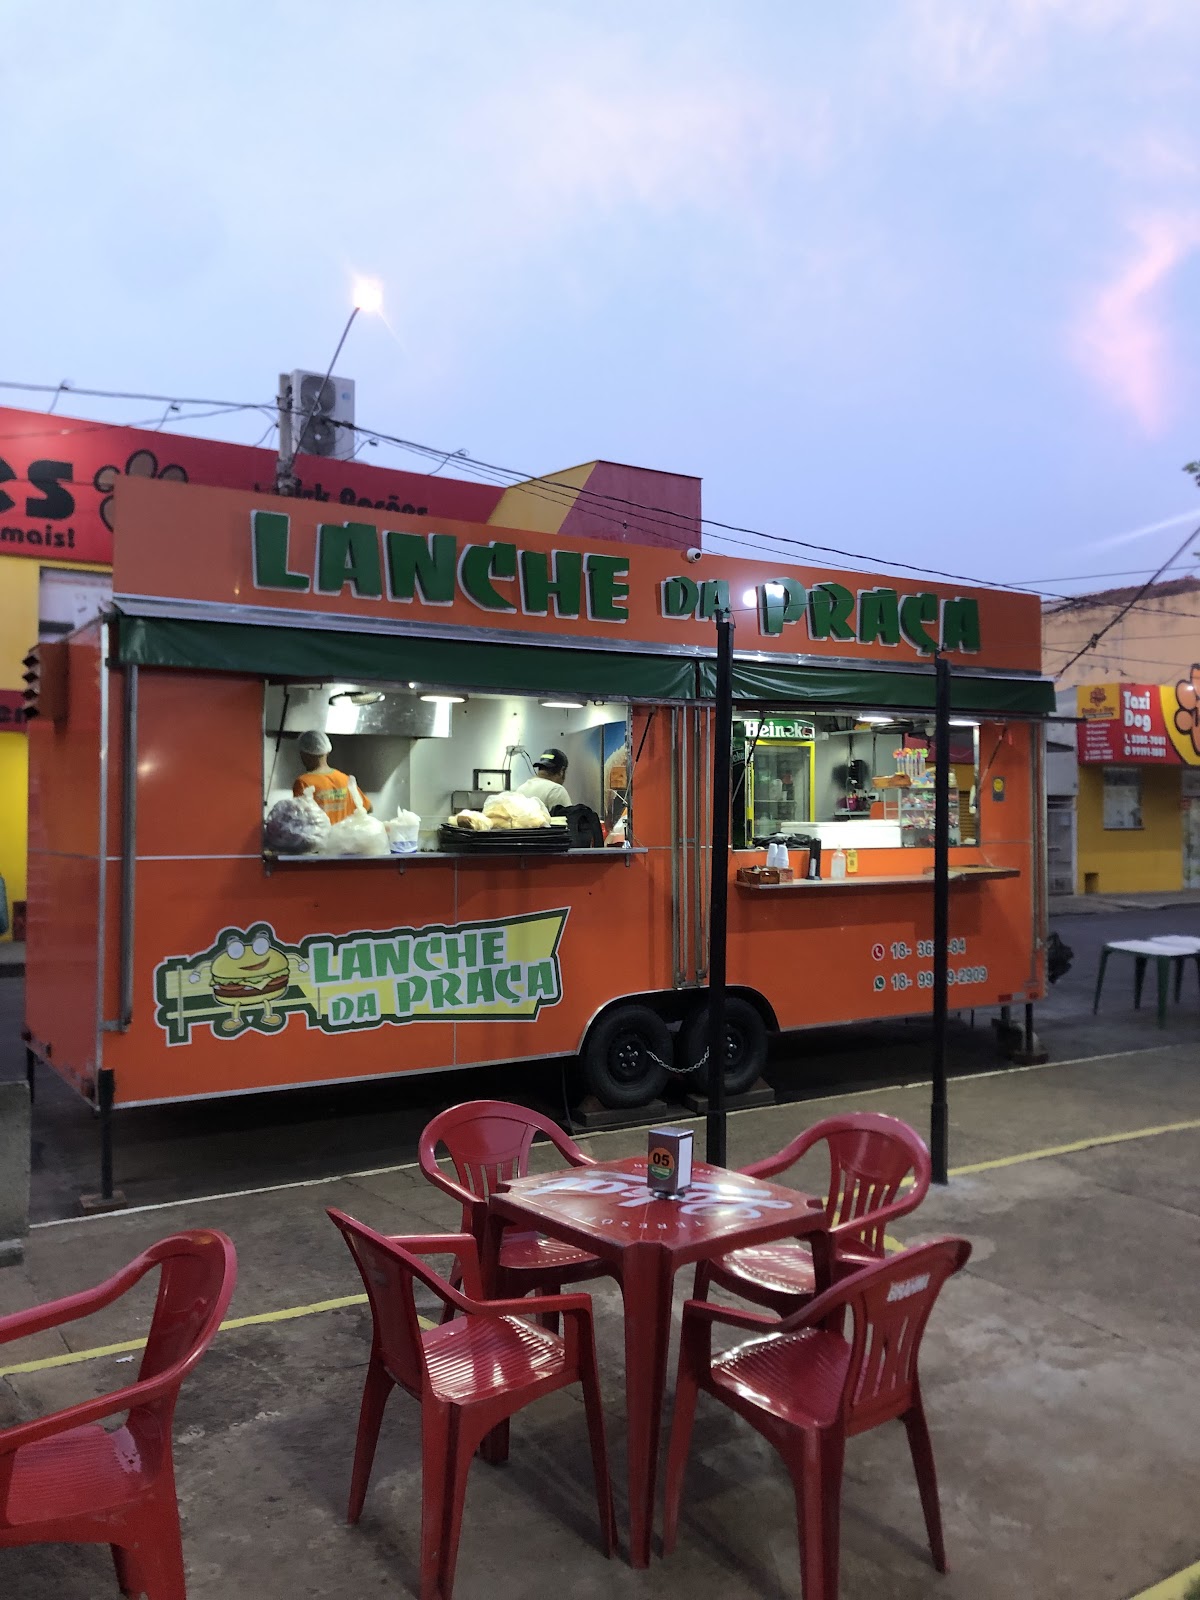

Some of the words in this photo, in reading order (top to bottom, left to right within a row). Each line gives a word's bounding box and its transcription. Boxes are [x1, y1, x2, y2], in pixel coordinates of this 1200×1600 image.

[0, 525, 75, 549] mais!
[251, 509, 630, 623] LANCHE
[661, 576, 731, 622] DA
[757, 577, 981, 657] PRAÇA
[1123, 691, 1150, 709] Taxi
[1124, 710, 1151, 732] Dog
[312, 931, 505, 984] LANCHE
[917, 938, 966, 957] 36-84
[331, 993, 377, 1022] DA
[396, 961, 555, 1013] PRAÇA
[652, 1152, 670, 1167] 05
